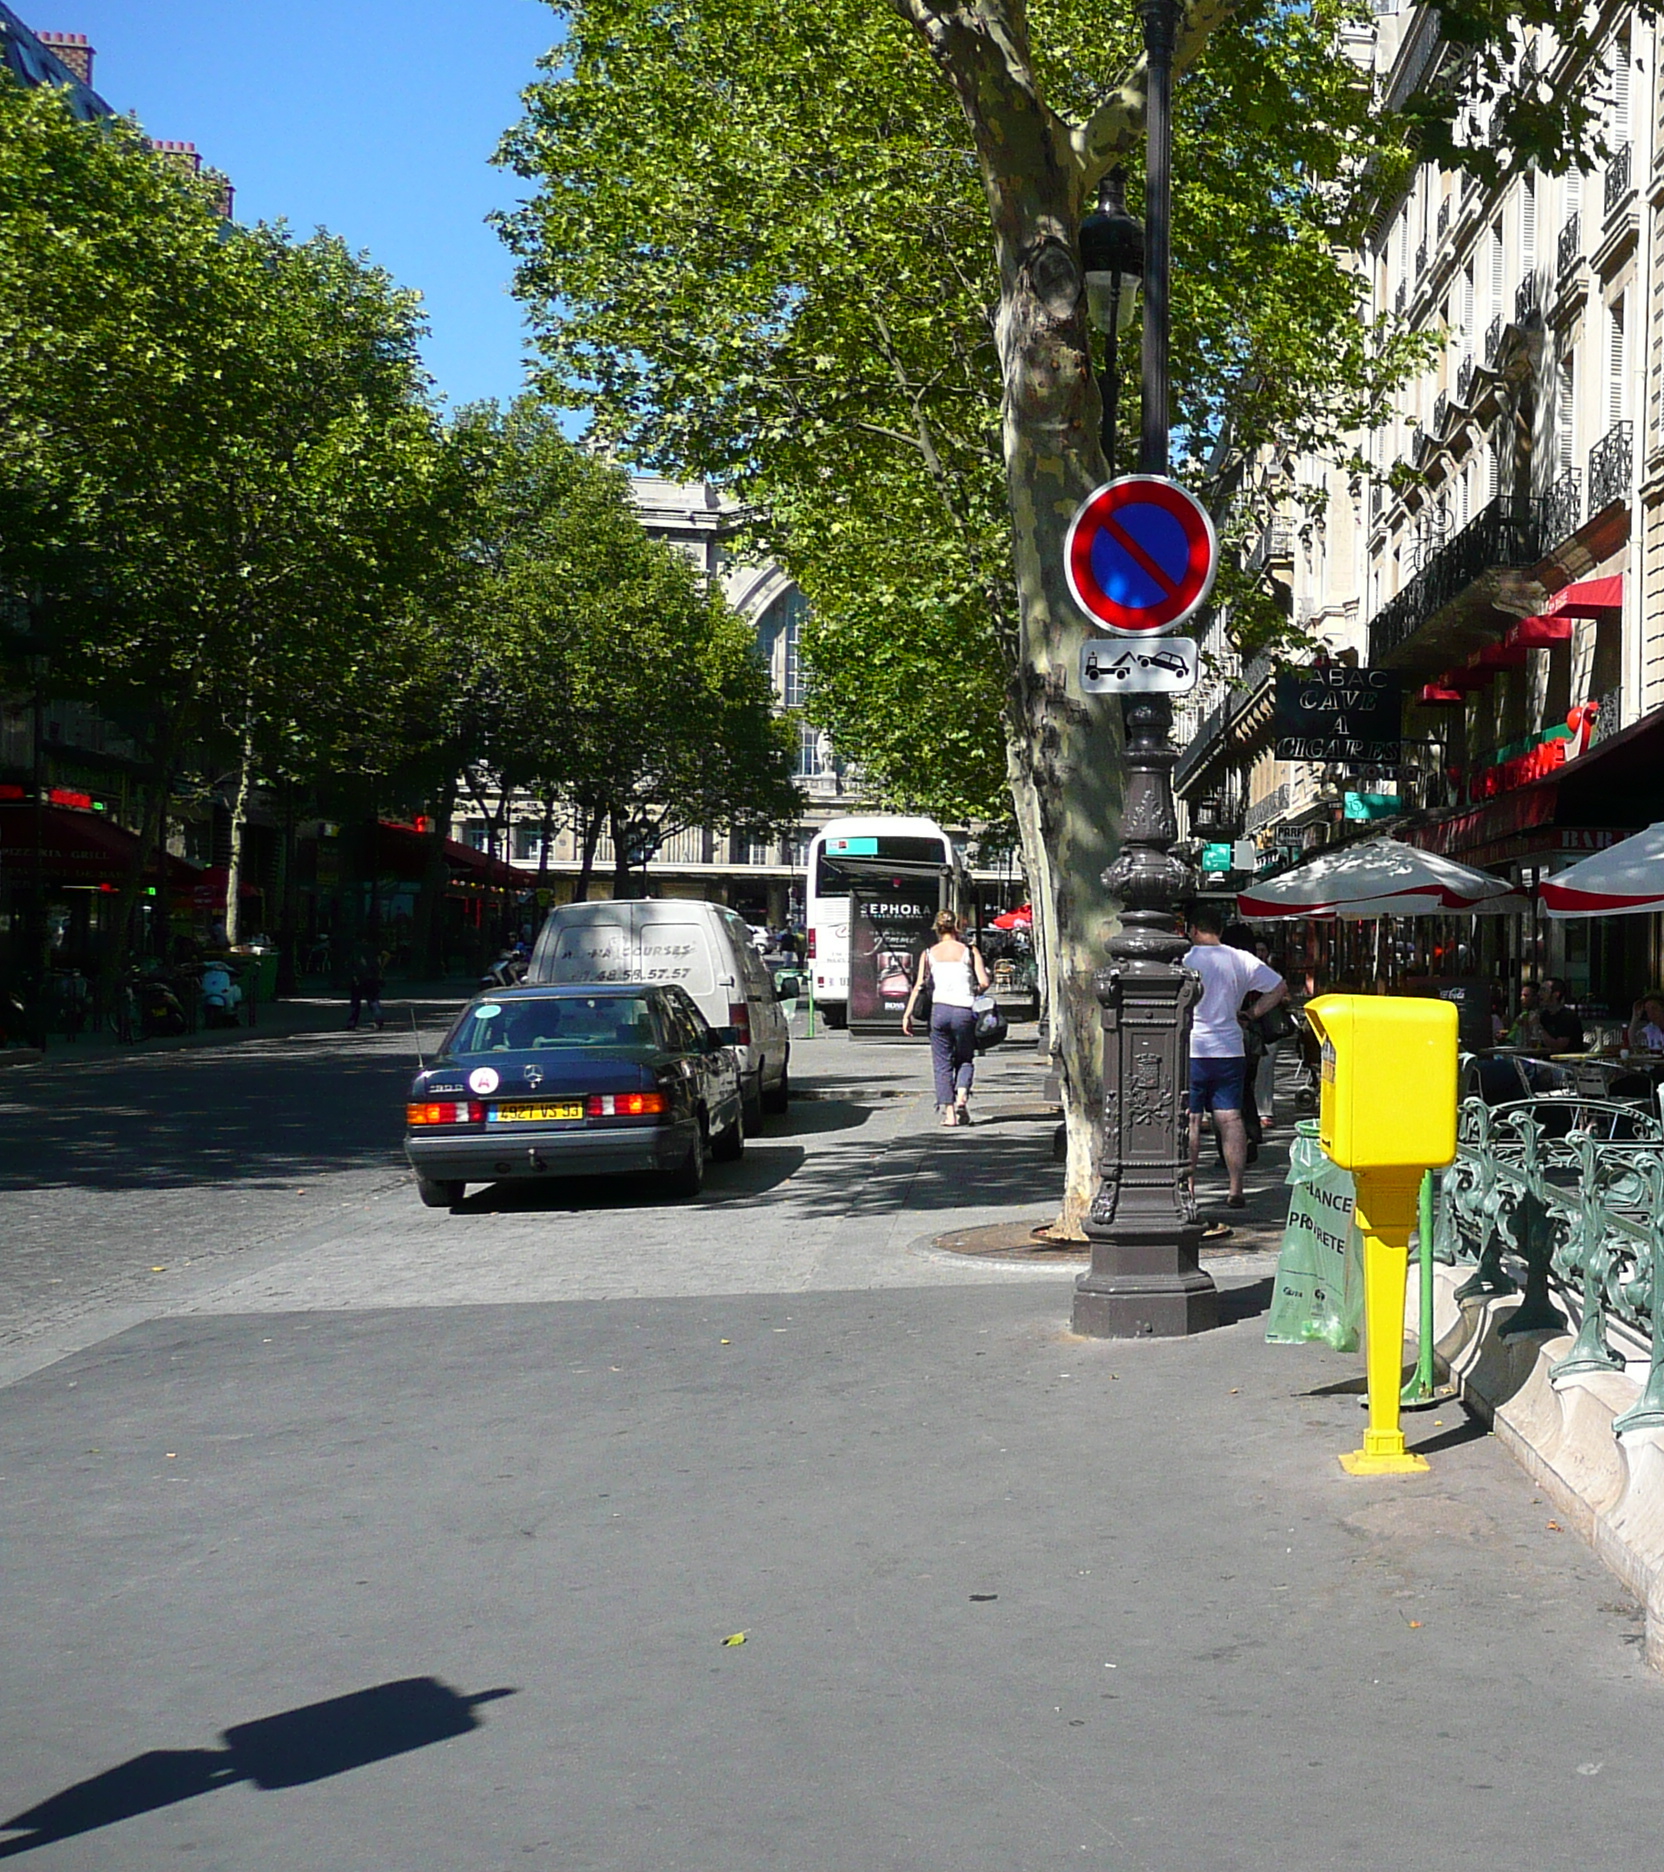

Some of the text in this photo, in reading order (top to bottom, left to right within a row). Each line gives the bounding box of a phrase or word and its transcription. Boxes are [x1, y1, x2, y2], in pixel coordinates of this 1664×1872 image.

[1298, 668, 1388, 688] ABAC
[1299, 689, 1378, 711] CAVE
[1276, 737, 1400, 760] CIGARES
[1561, 830, 1613, 849] BAR
[70, 851, 110, 860] GRILL
[860, 903, 931, 915] SEPHORA
[500, 1101, 579, 1119] 4927 VS 93
[1306, 1179, 1353, 1213] LANCE
